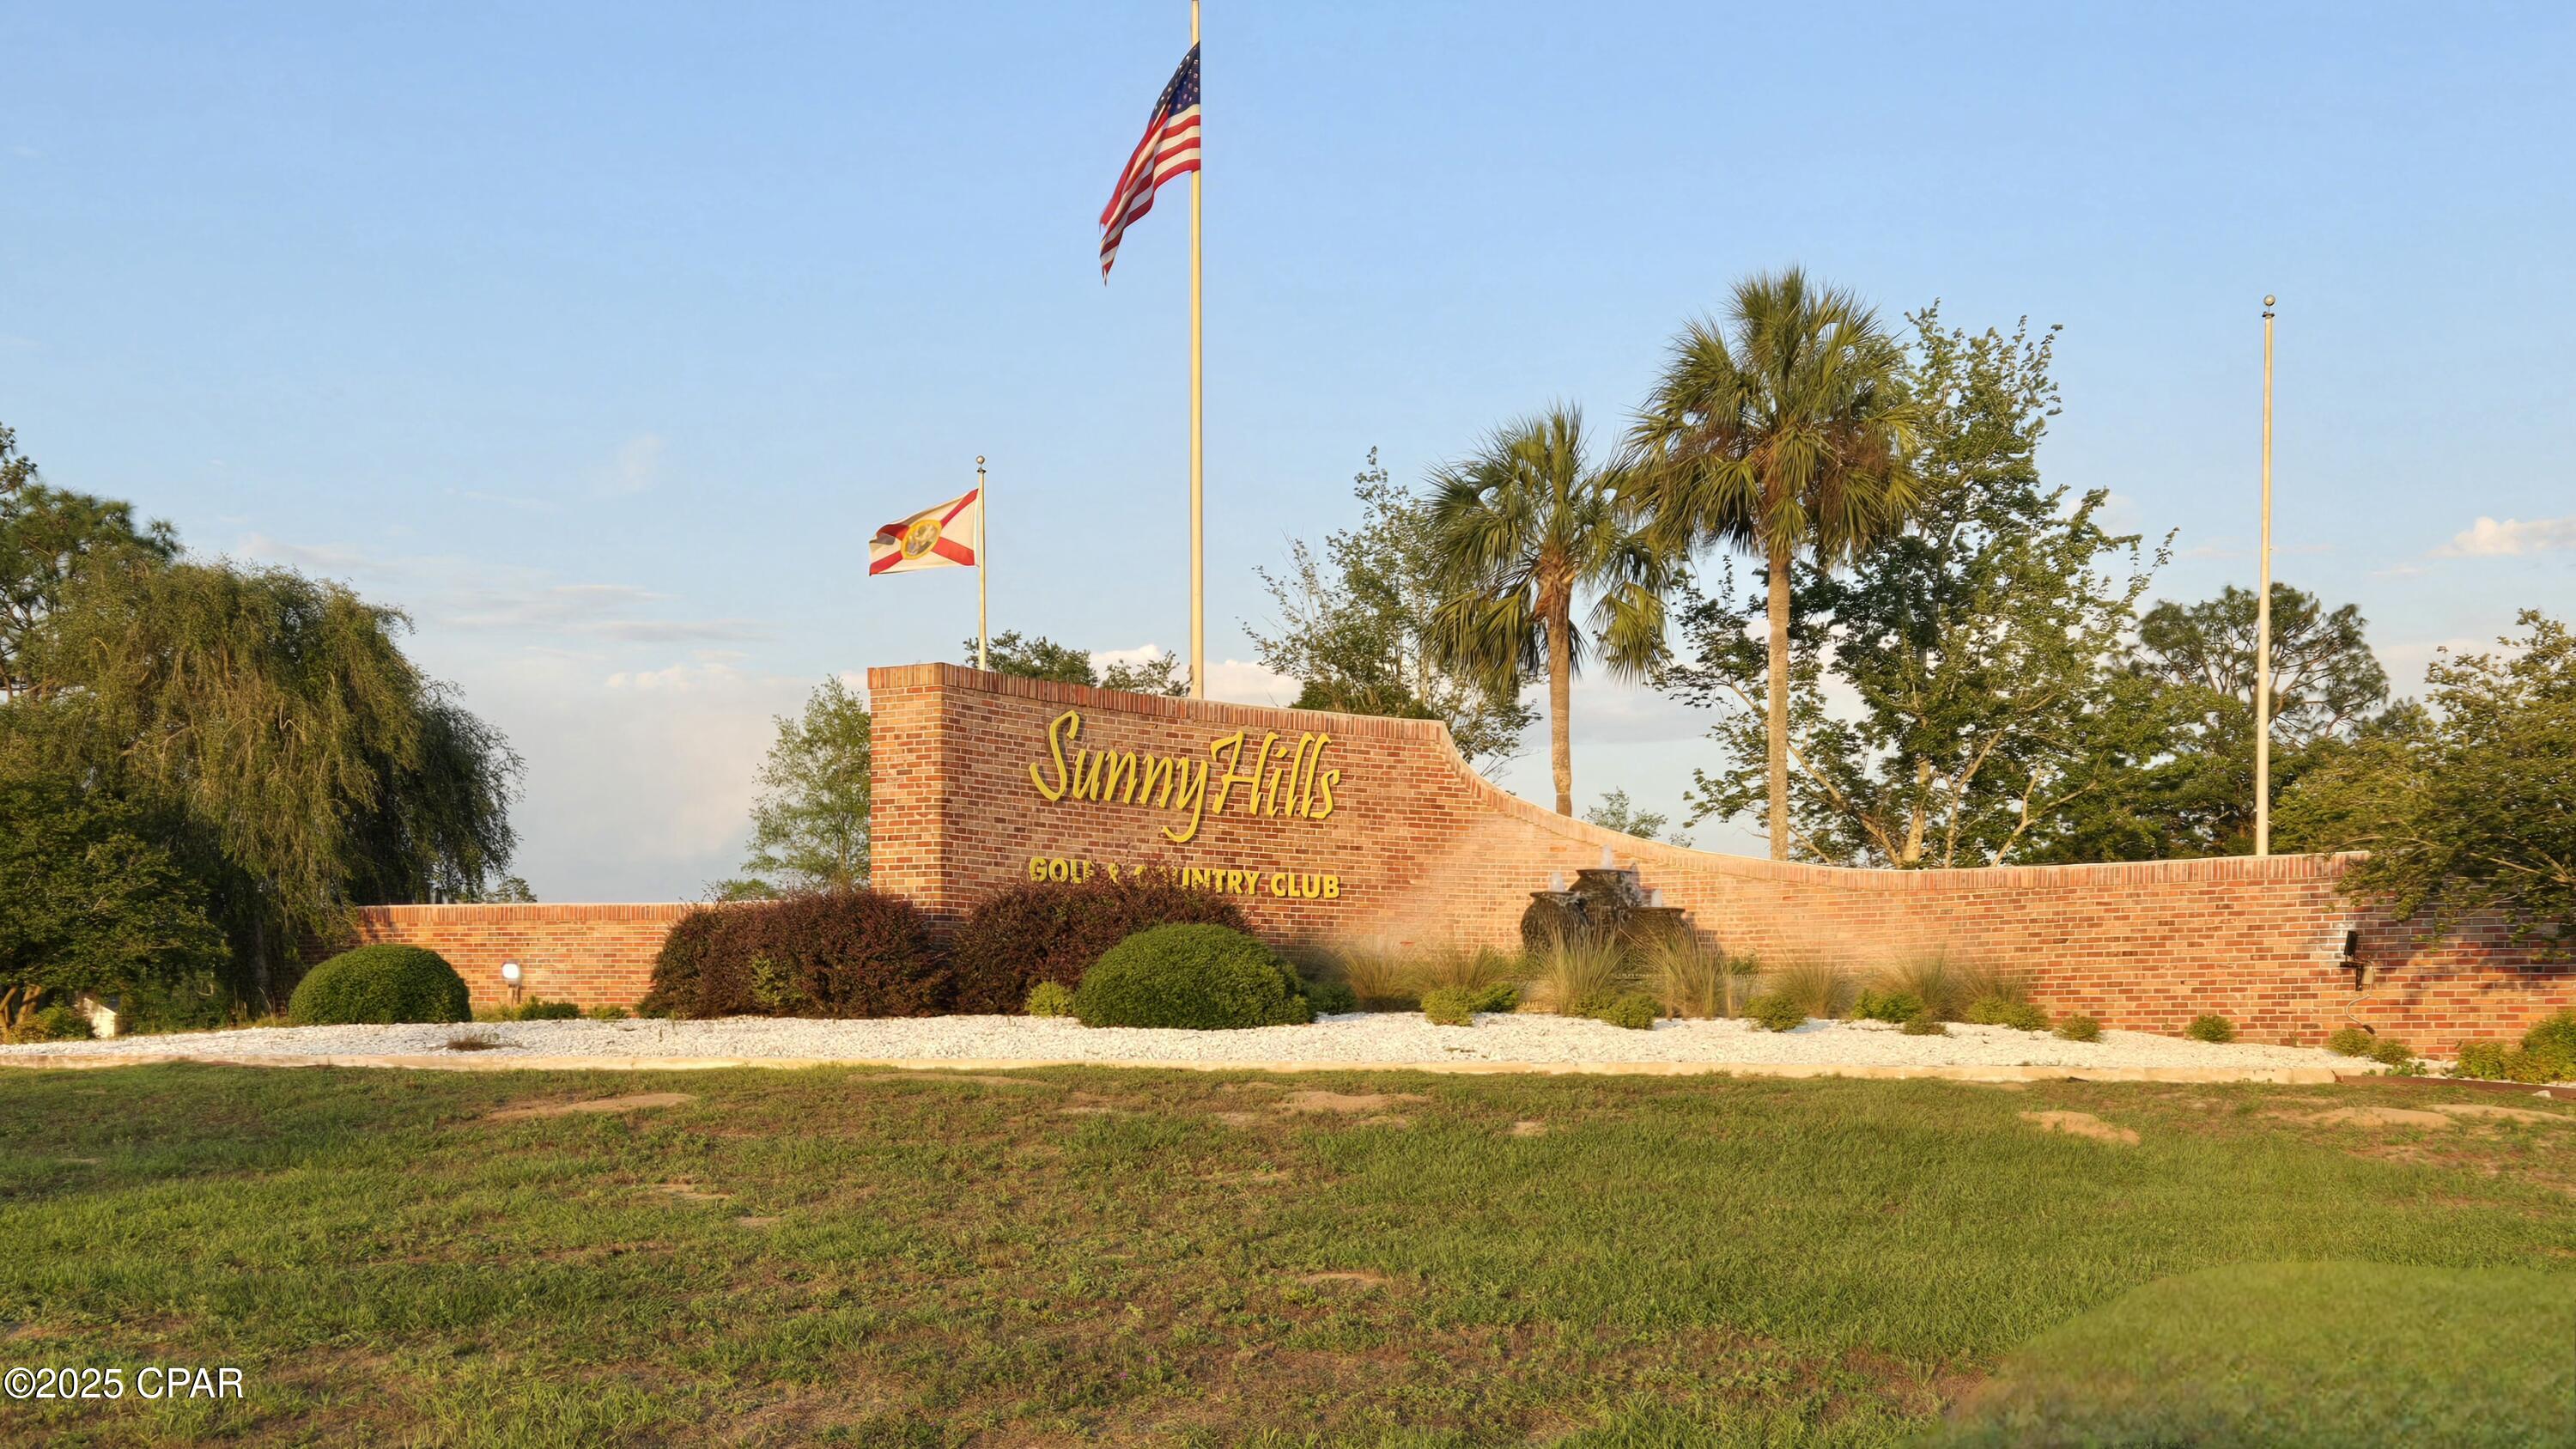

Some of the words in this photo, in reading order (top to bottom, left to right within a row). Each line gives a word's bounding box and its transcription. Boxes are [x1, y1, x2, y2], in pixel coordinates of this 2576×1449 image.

[1029, 709, 1209, 843] Sunny
[1210, 729, 1341, 819] Hills
[1270, 873, 1340, 899] CLUB
